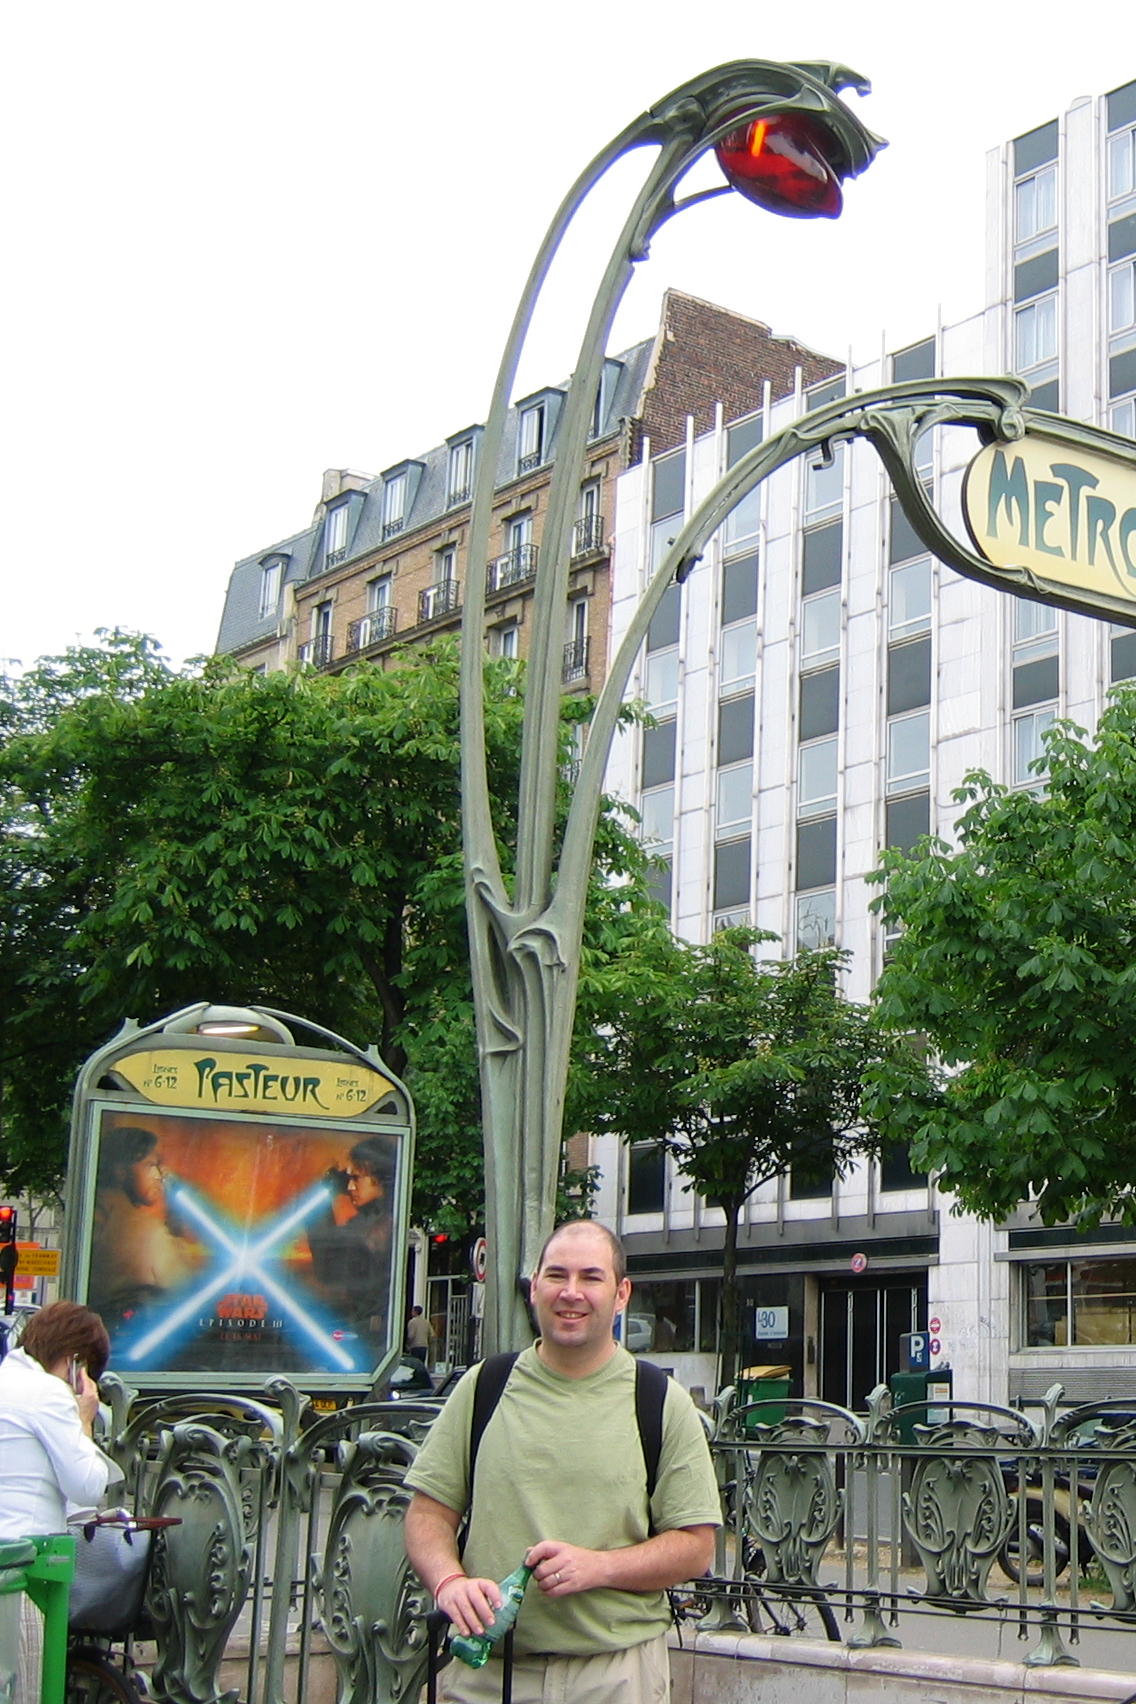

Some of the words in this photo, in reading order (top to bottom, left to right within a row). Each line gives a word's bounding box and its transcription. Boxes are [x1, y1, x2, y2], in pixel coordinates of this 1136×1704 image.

[193, 1057, 330, 1110] PASTEUR
[216, 1294, 266, 1306] STAR
[217, 1305, 268, 1318] WARS
[199, 1319, 266, 1328] EPISODE
